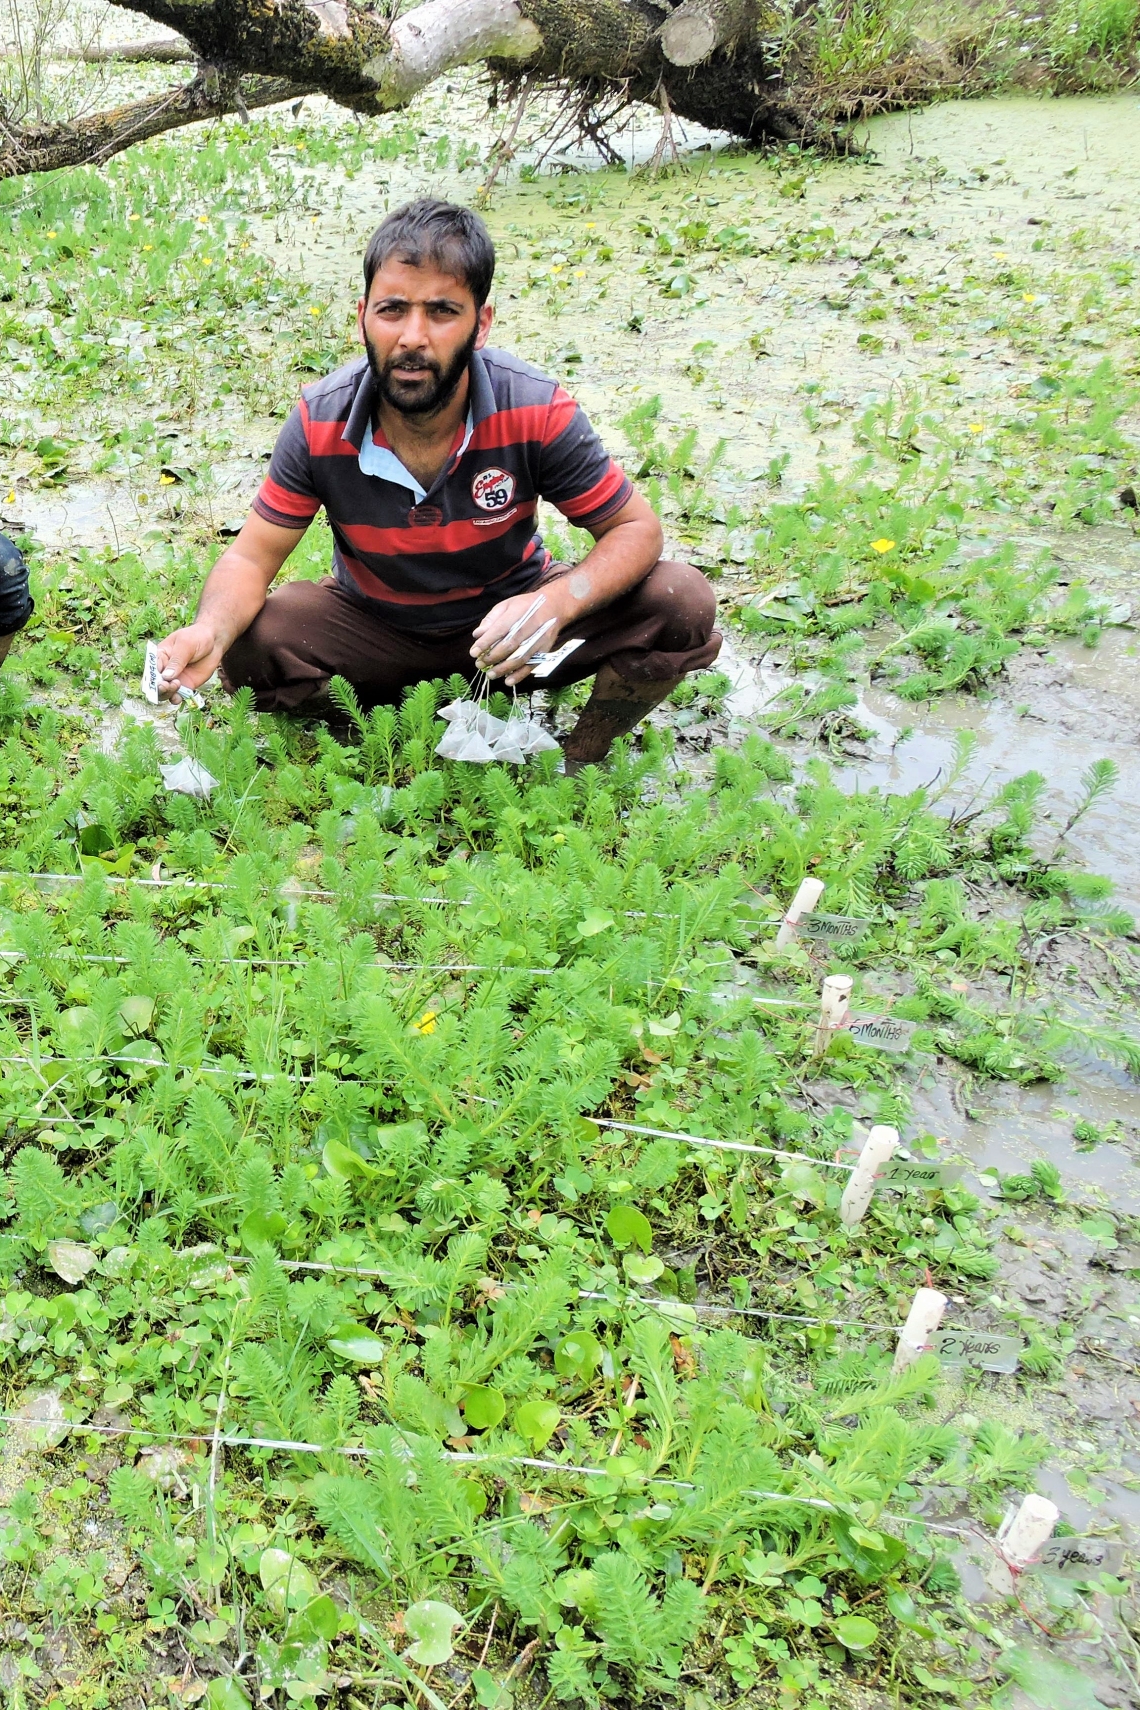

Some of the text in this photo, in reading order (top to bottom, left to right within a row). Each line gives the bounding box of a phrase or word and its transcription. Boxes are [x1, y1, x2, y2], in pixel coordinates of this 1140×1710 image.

[485, 488, 508, 508] 59
[887, 1167, 900, 1180] 1
[940, 1337, 956, 1355] 2
[1042, 1546, 1061, 1565] 3
